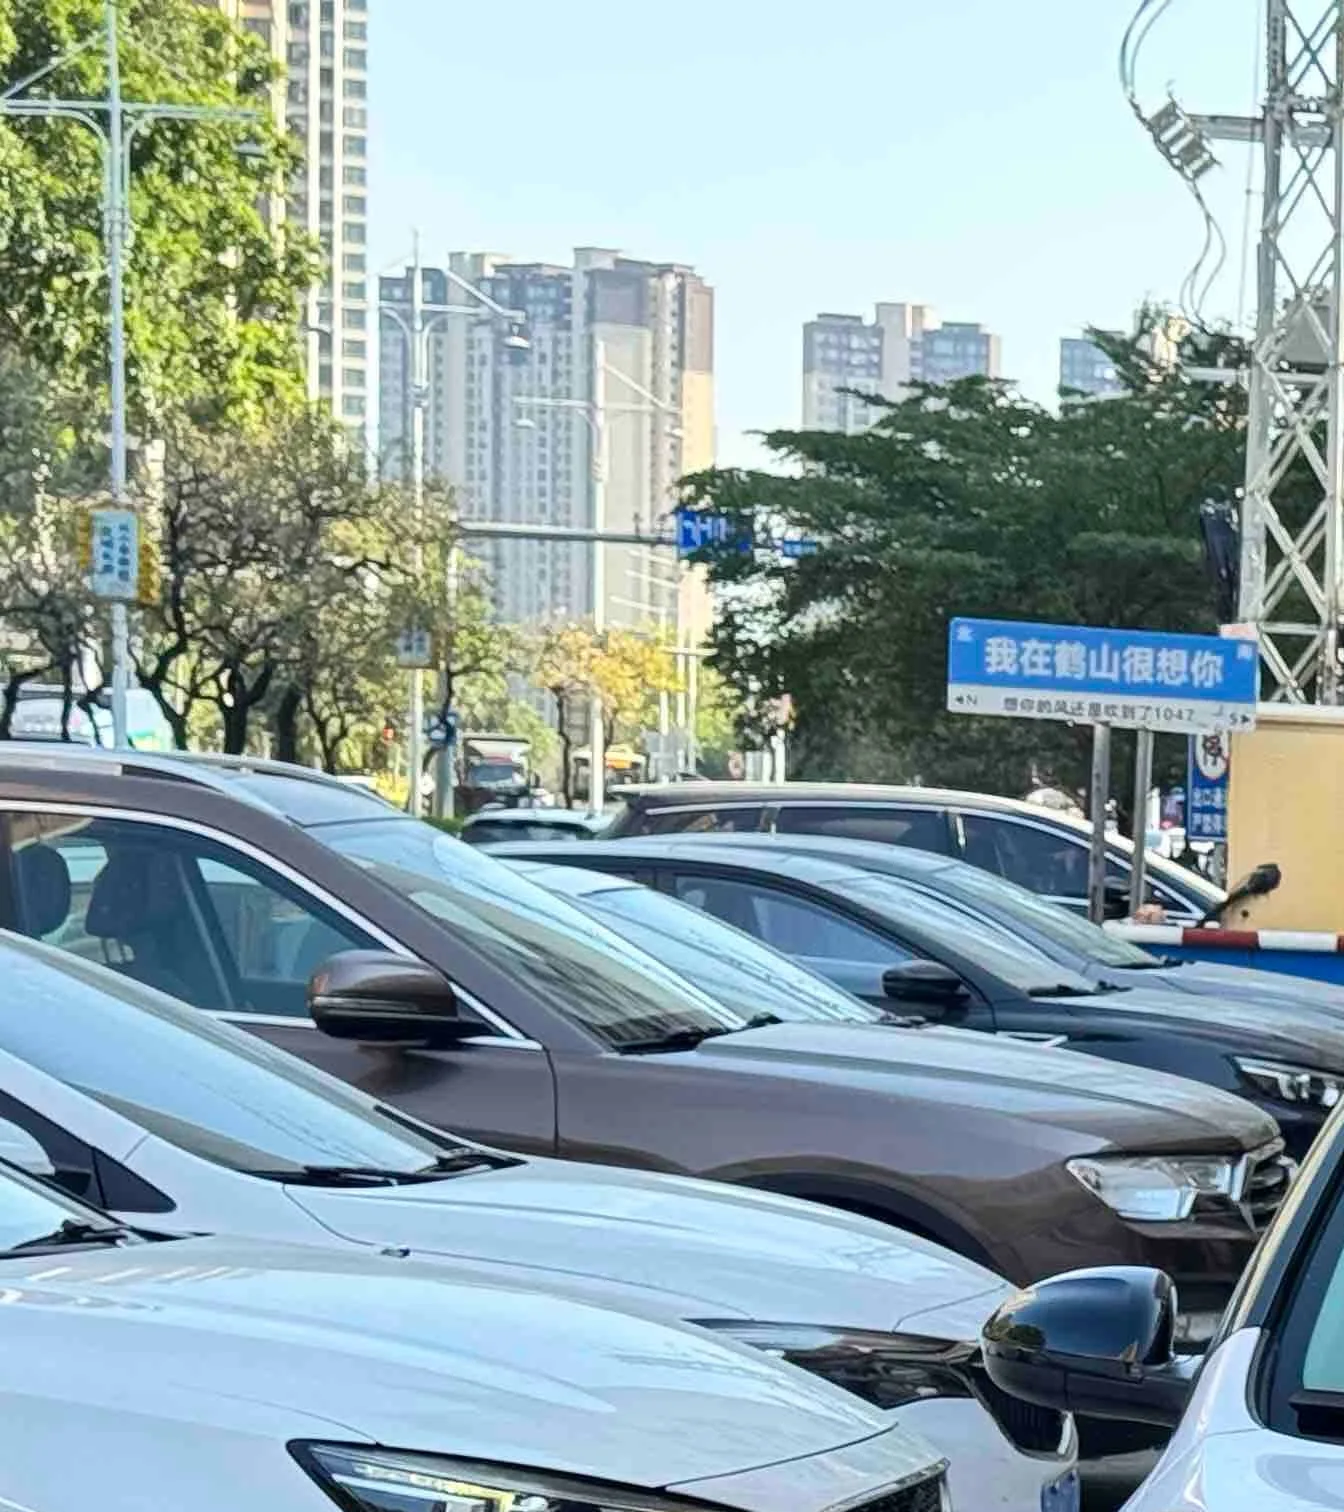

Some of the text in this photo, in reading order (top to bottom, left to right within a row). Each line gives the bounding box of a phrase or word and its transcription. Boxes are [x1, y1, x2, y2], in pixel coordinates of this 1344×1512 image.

[984, 635, 1225, 689] 我在鹤山很想你
